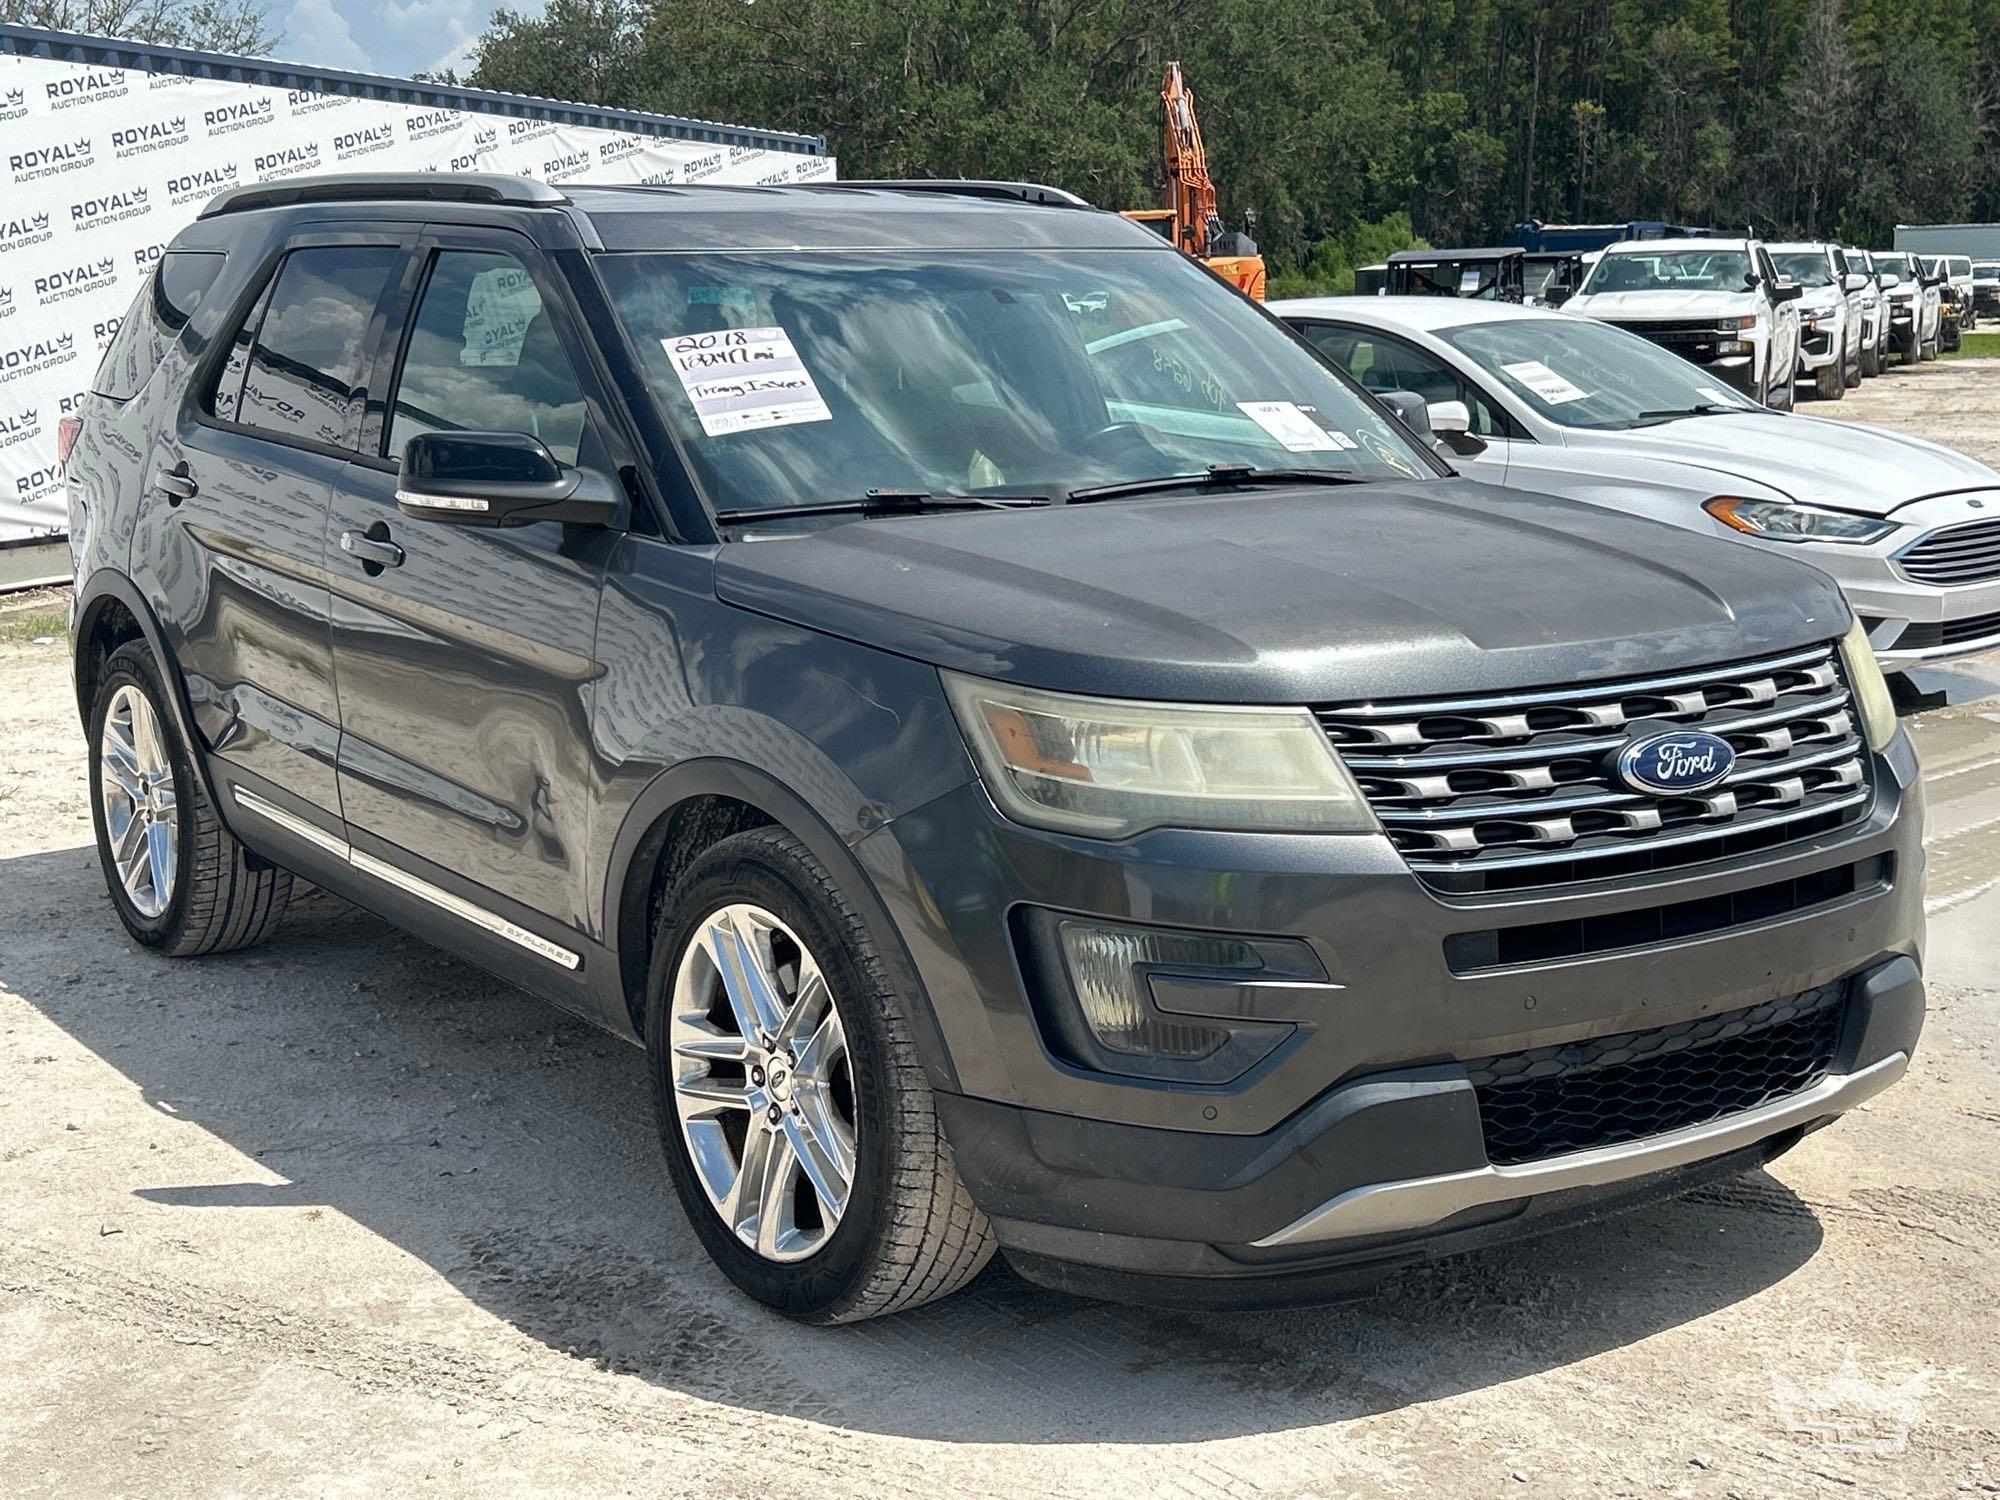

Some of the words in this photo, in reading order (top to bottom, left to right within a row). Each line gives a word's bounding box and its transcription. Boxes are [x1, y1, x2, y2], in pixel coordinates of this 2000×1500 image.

[46, 73, 110, 99] ROYAL
[51, 94, 94, 111] AUCTION
[95, 87, 129, 101] GROUP
[288, 90, 330, 106] ROY
[0, 108, 28, 121] ROUP
[204, 102, 259, 126] ROYAL
[291, 103, 325, 117] AUCTION
[406, 110, 450, 132] ROYAL
[111, 122, 172, 147] ROYAL
[208, 120, 245, 137] AUCTION
[246, 114, 275, 128] GROUP
[409, 127, 439, 142] AUCTION
[440, 121, 463, 134] GROUP
[116, 142, 157, 159] AUCTION
[158, 135, 189, 149] GROUP
[333, 128, 381, 150] ROYAL
[337, 146, 369, 161] AUCTION
[370, 140, 395, 151] GROUP
[600, 139, 634, 158] ROYAL
[9, 143, 76, 171] ROYAL
[255, 148, 306, 171] ROYAL
[451, 154, 477, 172] ROY
[544, 154, 580, 174] ROYAL
[684, 157, 714, 175] ROYAL
[796, 158, 822, 174] ROYAL
[14, 164, 59, 184] AUCTION
[60, 157, 95, 172] GROUP
[167, 169, 224, 195] ROYAL
[258, 166, 293, 182] AUCTION
[294, 159, 321, 173] GROUP
[171, 190, 210, 206] AUCTION
[211, 181, 240, 196] GROUP
[71, 192, 133, 220] ROYAL
[0, 218, 33, 240] YAL
[75, 214, 117, 232] AUCTION
[118, 206, 151, 221] GROUP
[17, 231, 53, 248] GROUP
[35, 264, 99, 294] ROYAL
[39, 287, 82, 306] AUCTION
[83, 275, 117, 292] GROUP
[485, 322, 515, 344] OYAL
[675, 331, 748, 354] 2018
[42, 351, 78, 368] GROUP
[5, 426, 42, 447] GROUP
[16, 464, 63, 493] ROY
[20, 481, 66, 505] AUCTION
[1656, 741, 1716, 779] Ford
[506, 926, 573, 964] EXPLORER
